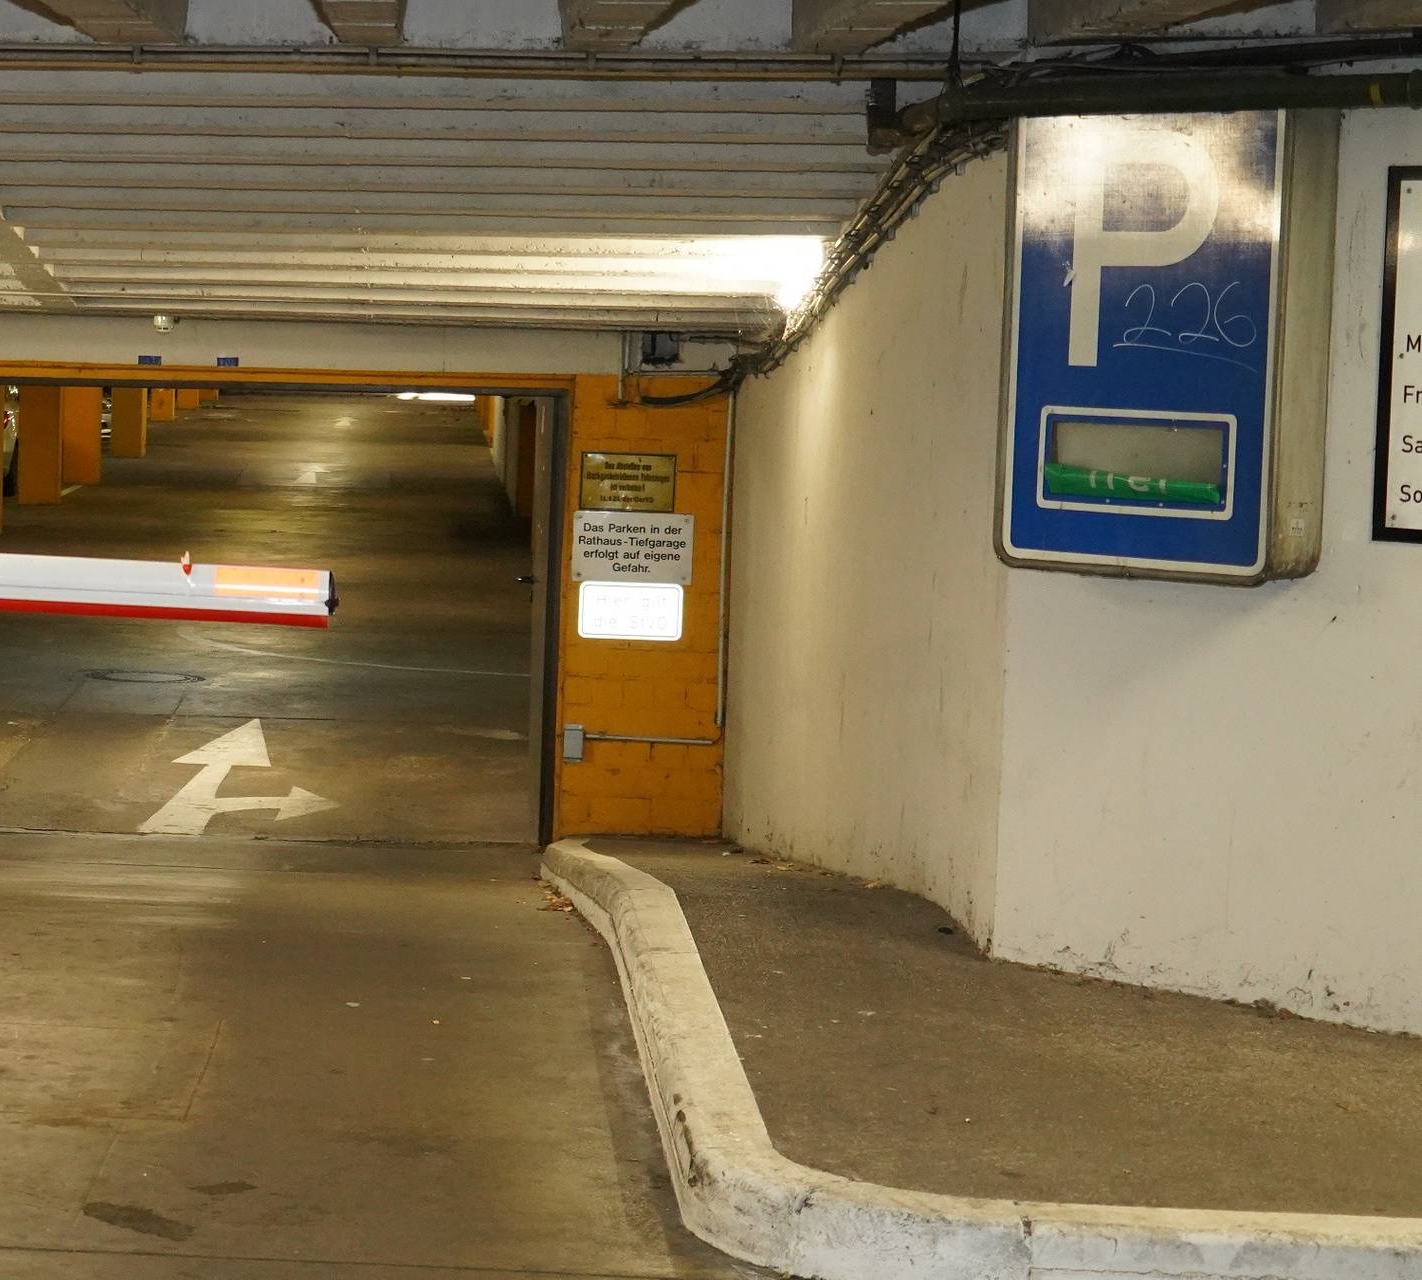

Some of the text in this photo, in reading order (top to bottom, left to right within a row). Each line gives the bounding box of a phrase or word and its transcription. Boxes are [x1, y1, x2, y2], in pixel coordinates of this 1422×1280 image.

[1067, 130, 1219, 367] P
[1123, 281, 1257, 347] 226
[583, 522, 682, 535] Das Parken in der
[583, 549, 681, 562] erfolgt auf eigene
[612, 562, 651, 573] Gefahr.
